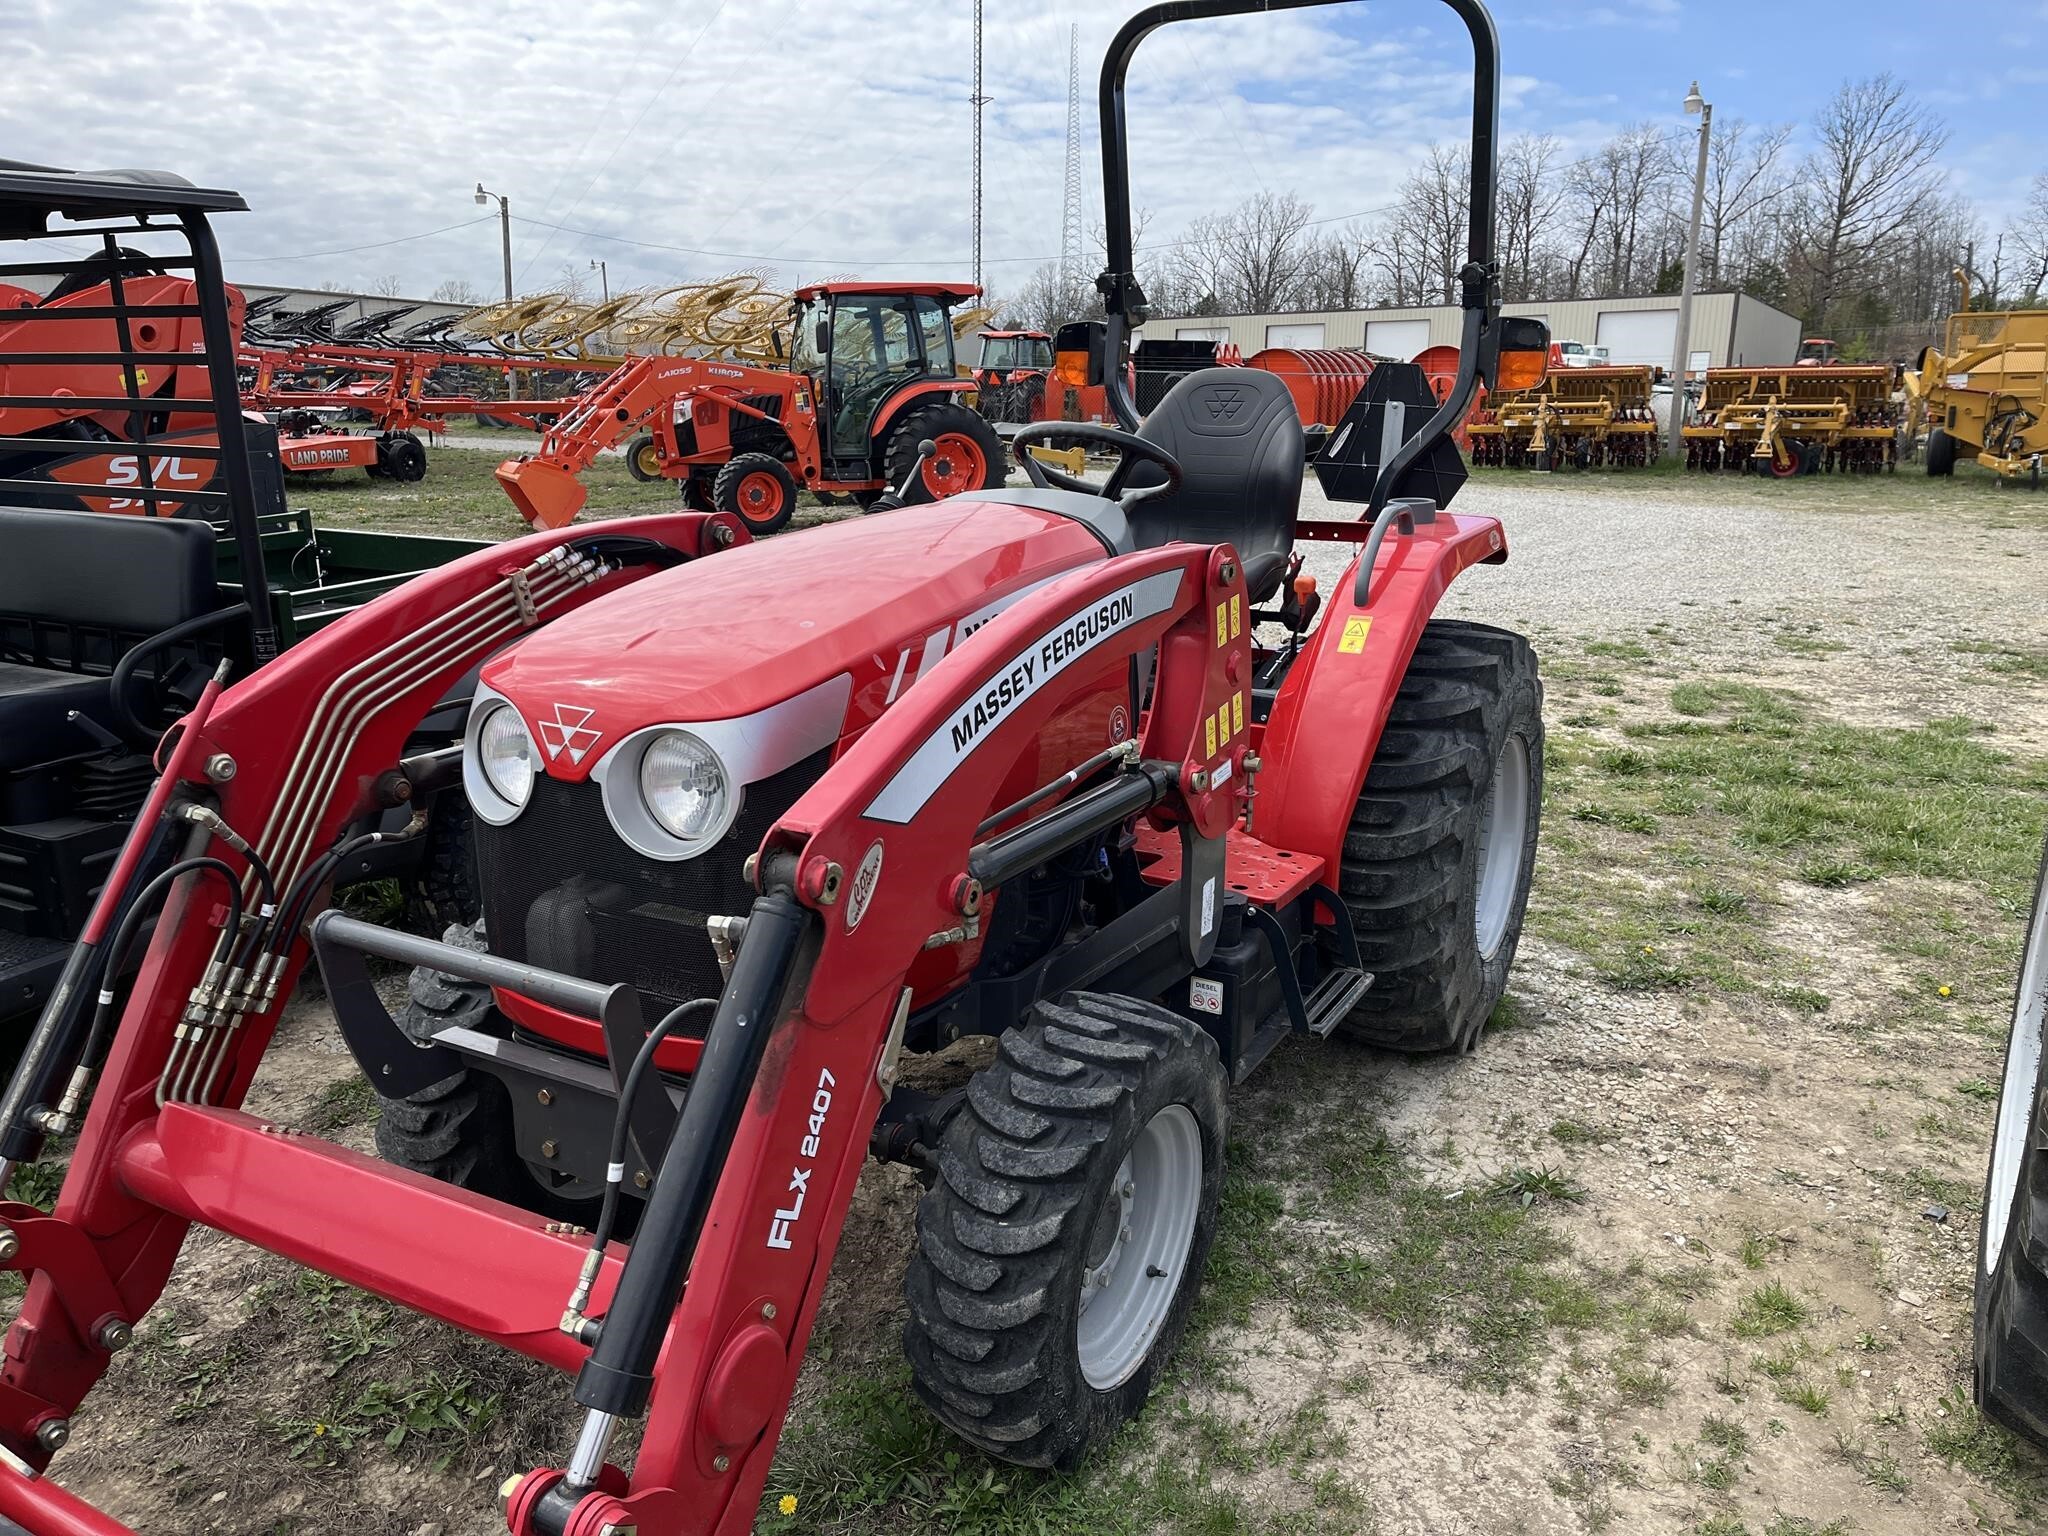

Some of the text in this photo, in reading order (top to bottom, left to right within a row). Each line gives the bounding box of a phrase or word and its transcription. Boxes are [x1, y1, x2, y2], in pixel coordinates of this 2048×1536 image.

[290, 448, 350, 465] LAND PRIDE
[950, 592, 1134, 753] MASSEY FERGUSON
[1195, 981, 1217, 991] DIESEL
[766, 1067, 836, 1250] FLX 2407
